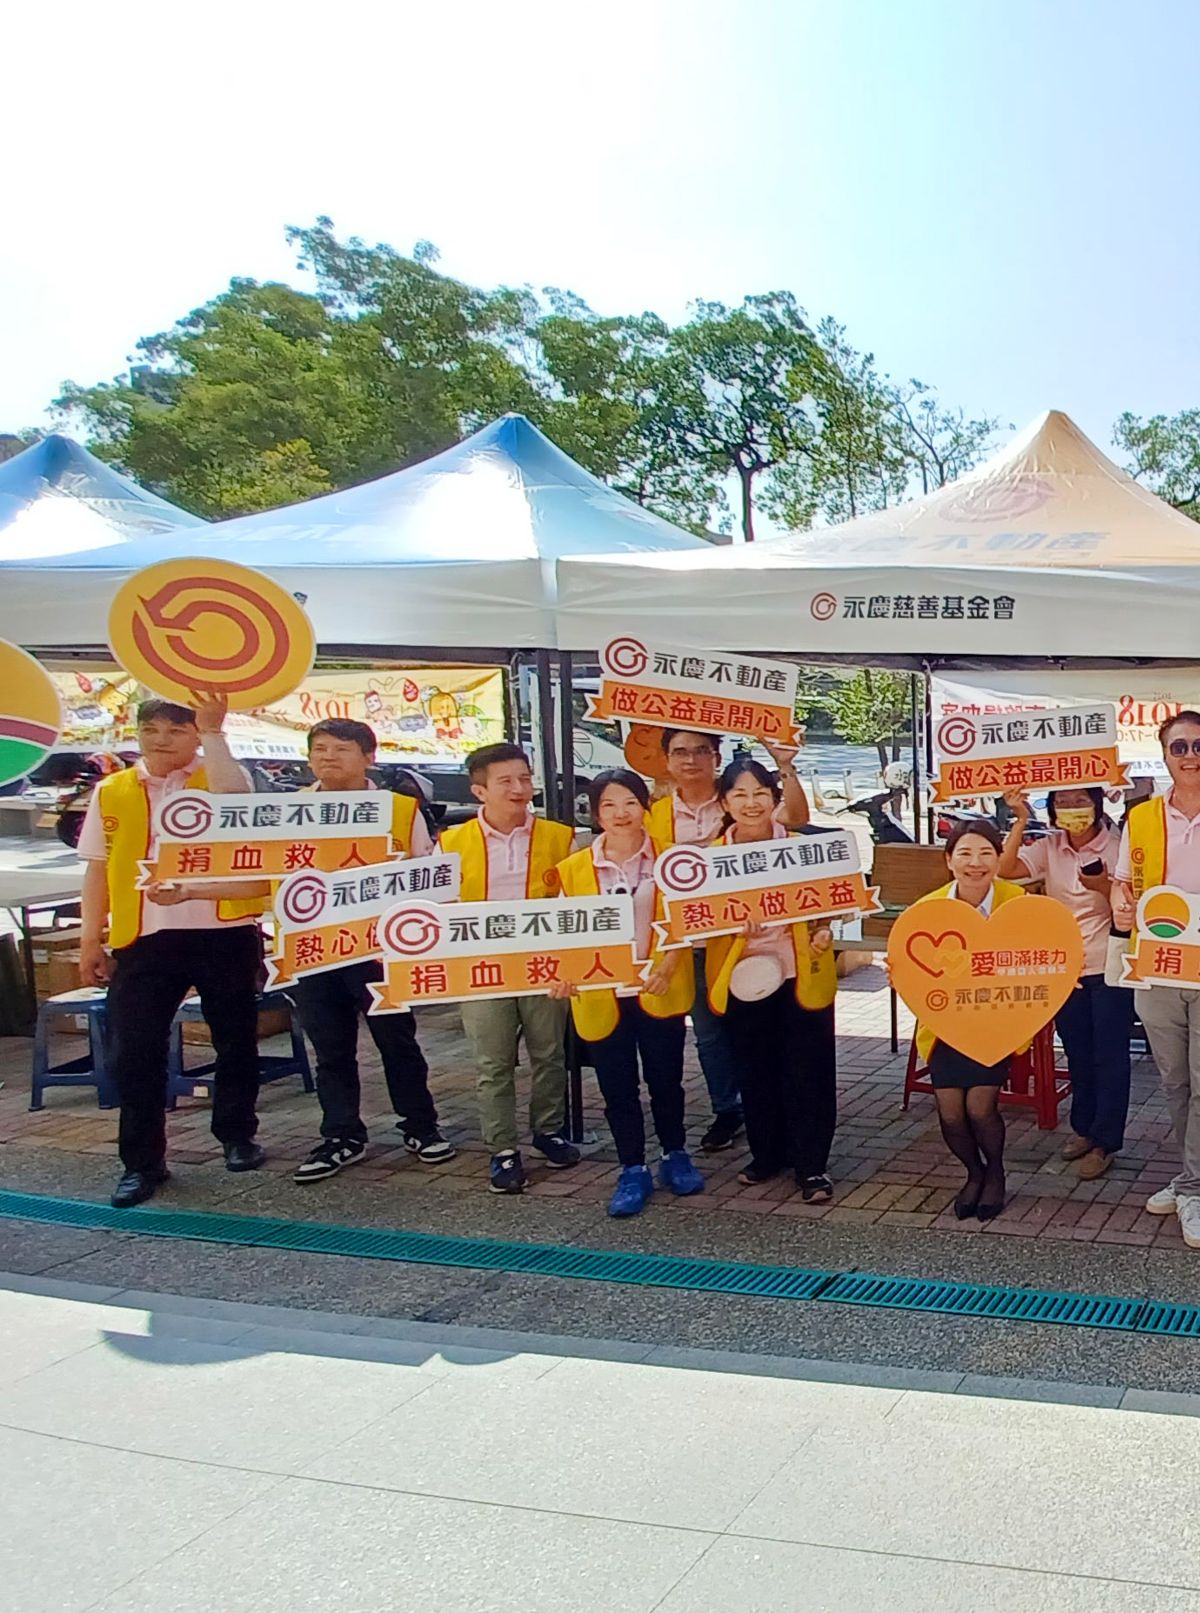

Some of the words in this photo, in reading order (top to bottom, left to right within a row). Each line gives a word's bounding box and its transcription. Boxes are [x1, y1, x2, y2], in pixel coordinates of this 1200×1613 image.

[842, 594, 1016, 620] 永慶慈善基金會
[652, 651, 788, 693] 永慶不動產
[610, 686, 782, 734] 做公益最開心
[980, 712, 1108, 745] 永慶不動產
[948, 754, 1110, 791] 做公益最開心
[218, 801, 380, 829] 永慶不動產
[177, 842, 369, 873] 捐血救人
[711, 839, 851, 879] 永慶不動產
[331, 863, 453, 908] 永慶不動產
[682, 880, 857, 931] 熱心做公益
[449, 906, 622, 943] 永慶不動產
[410, 952, 616, 995] 捐血救人
[970, 949, 1067, 977] 愛圓滿接力
[954, 983, 1049, 1005] 永慶不動產
